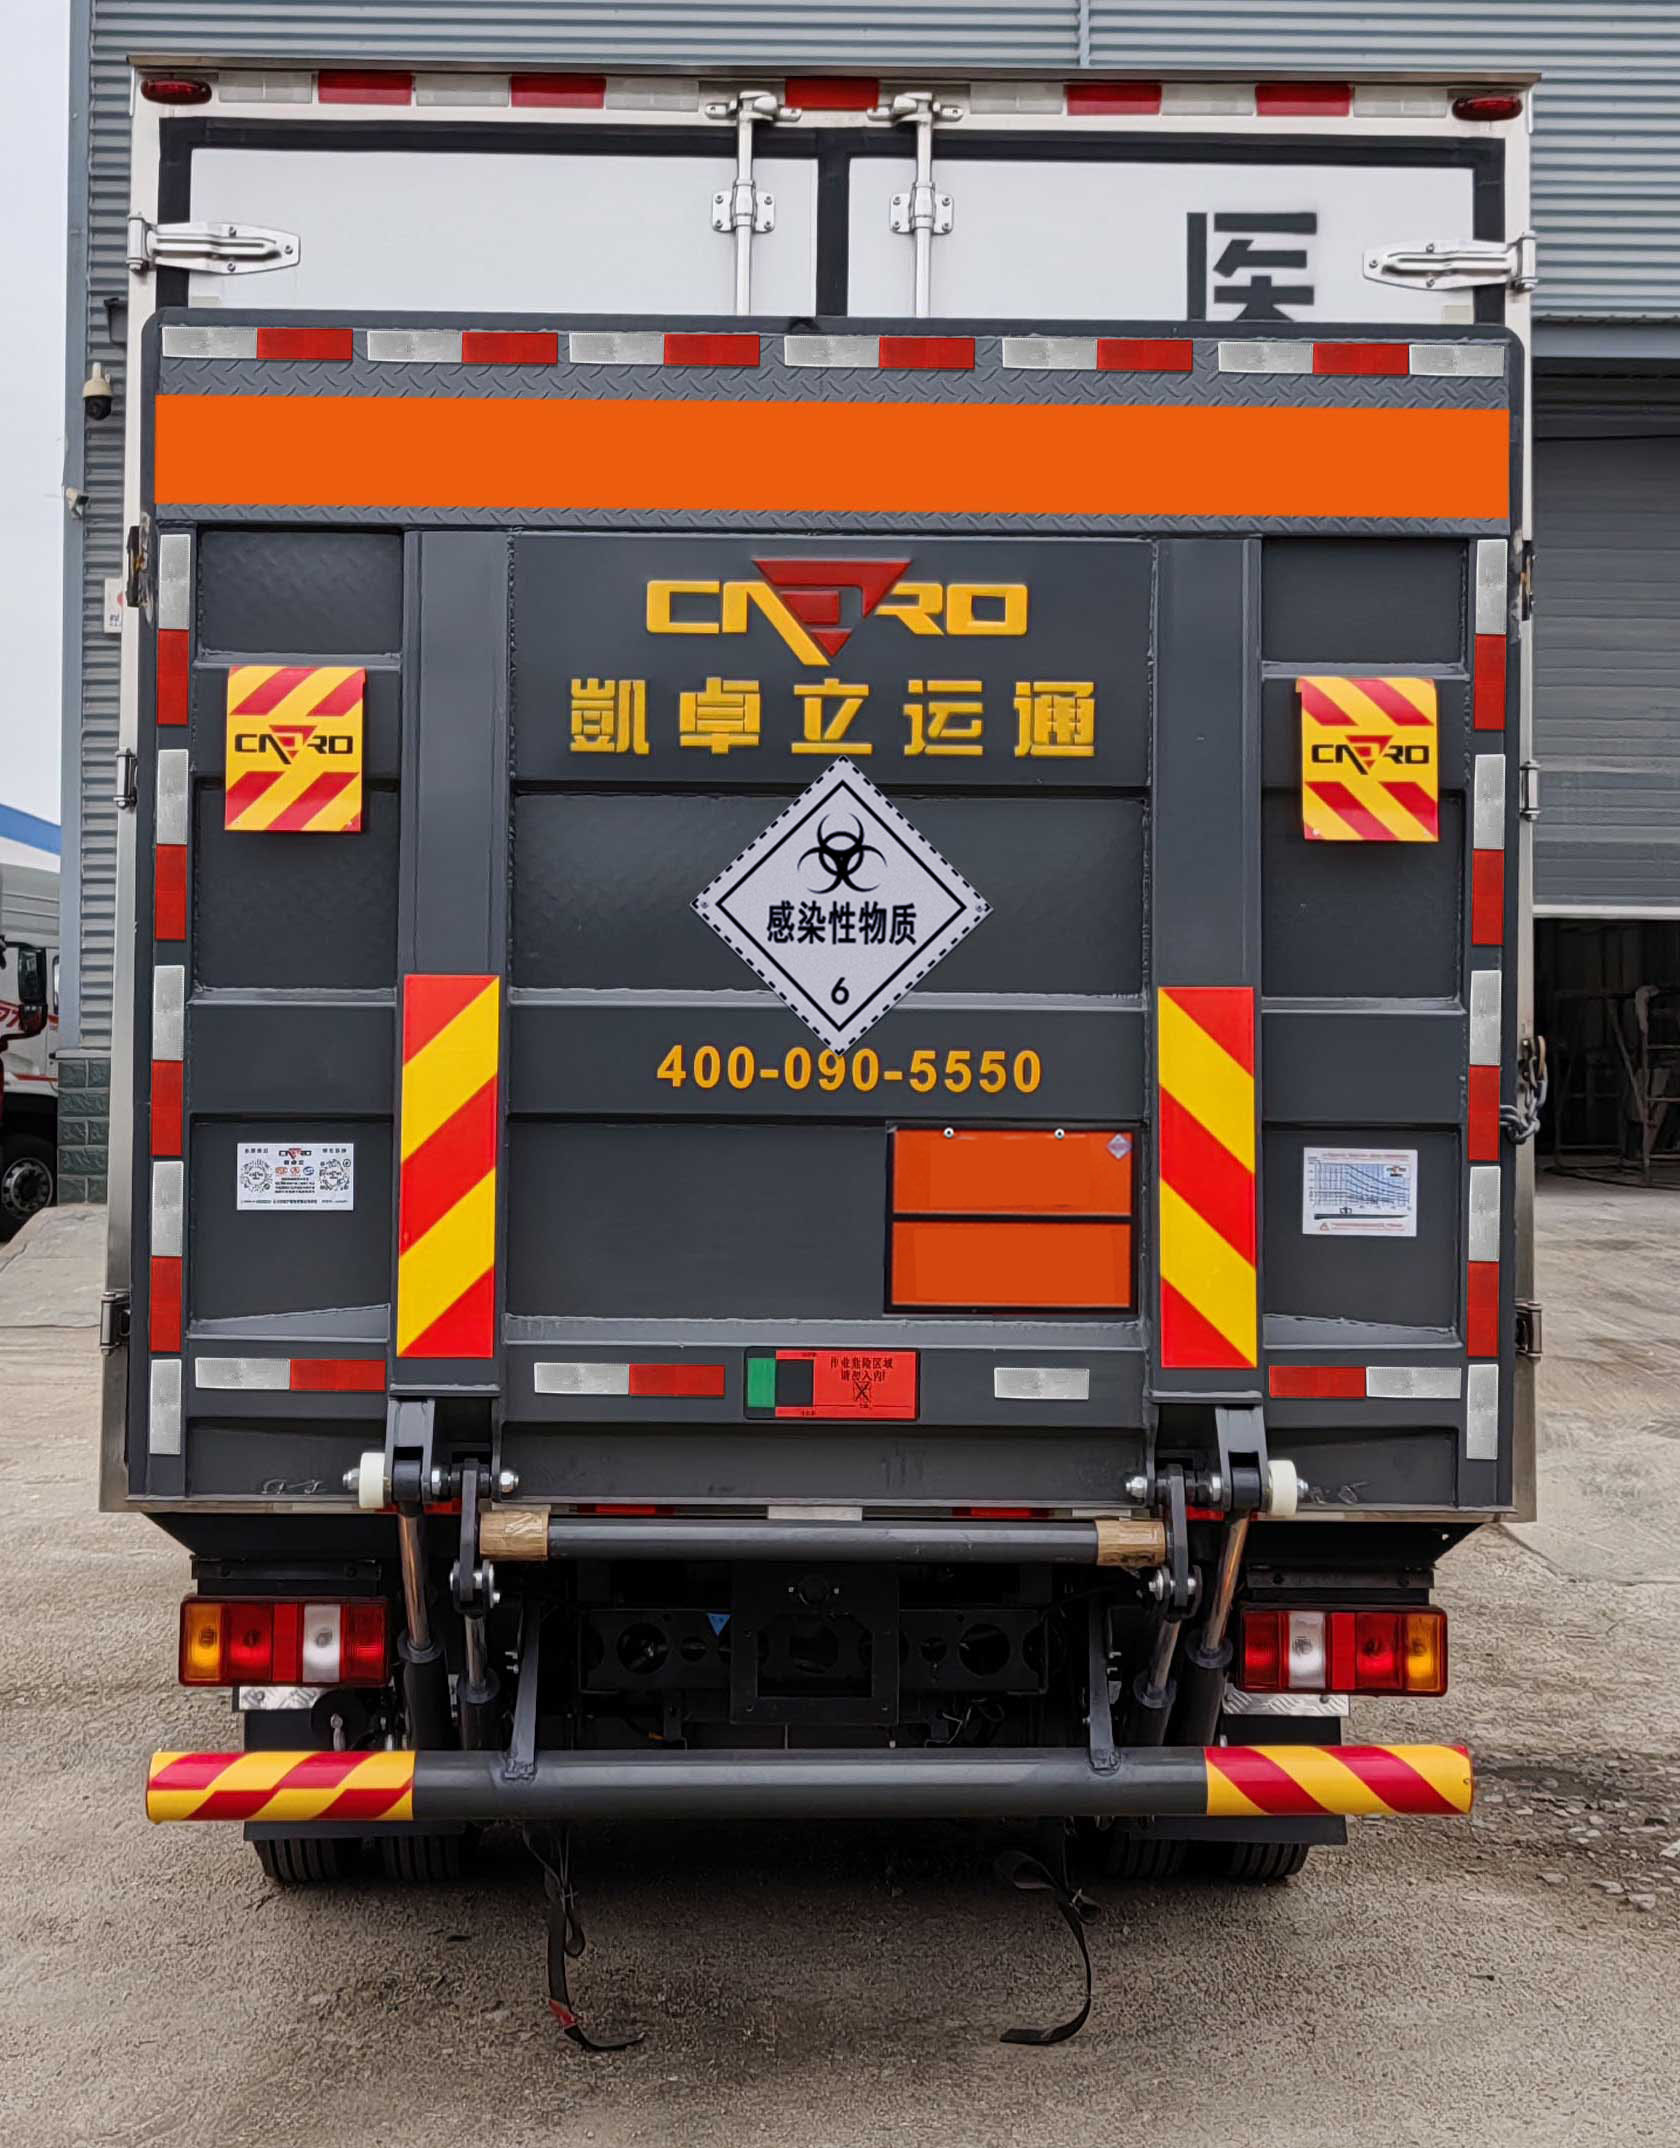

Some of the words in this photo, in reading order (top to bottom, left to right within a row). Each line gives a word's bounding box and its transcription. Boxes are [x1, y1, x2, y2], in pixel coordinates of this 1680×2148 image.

[766, 900, 918, 945] 感染性物质
[830, 977, 851, 1006] 6
[656, 1044, 1042, 1093] 400-090-5550
